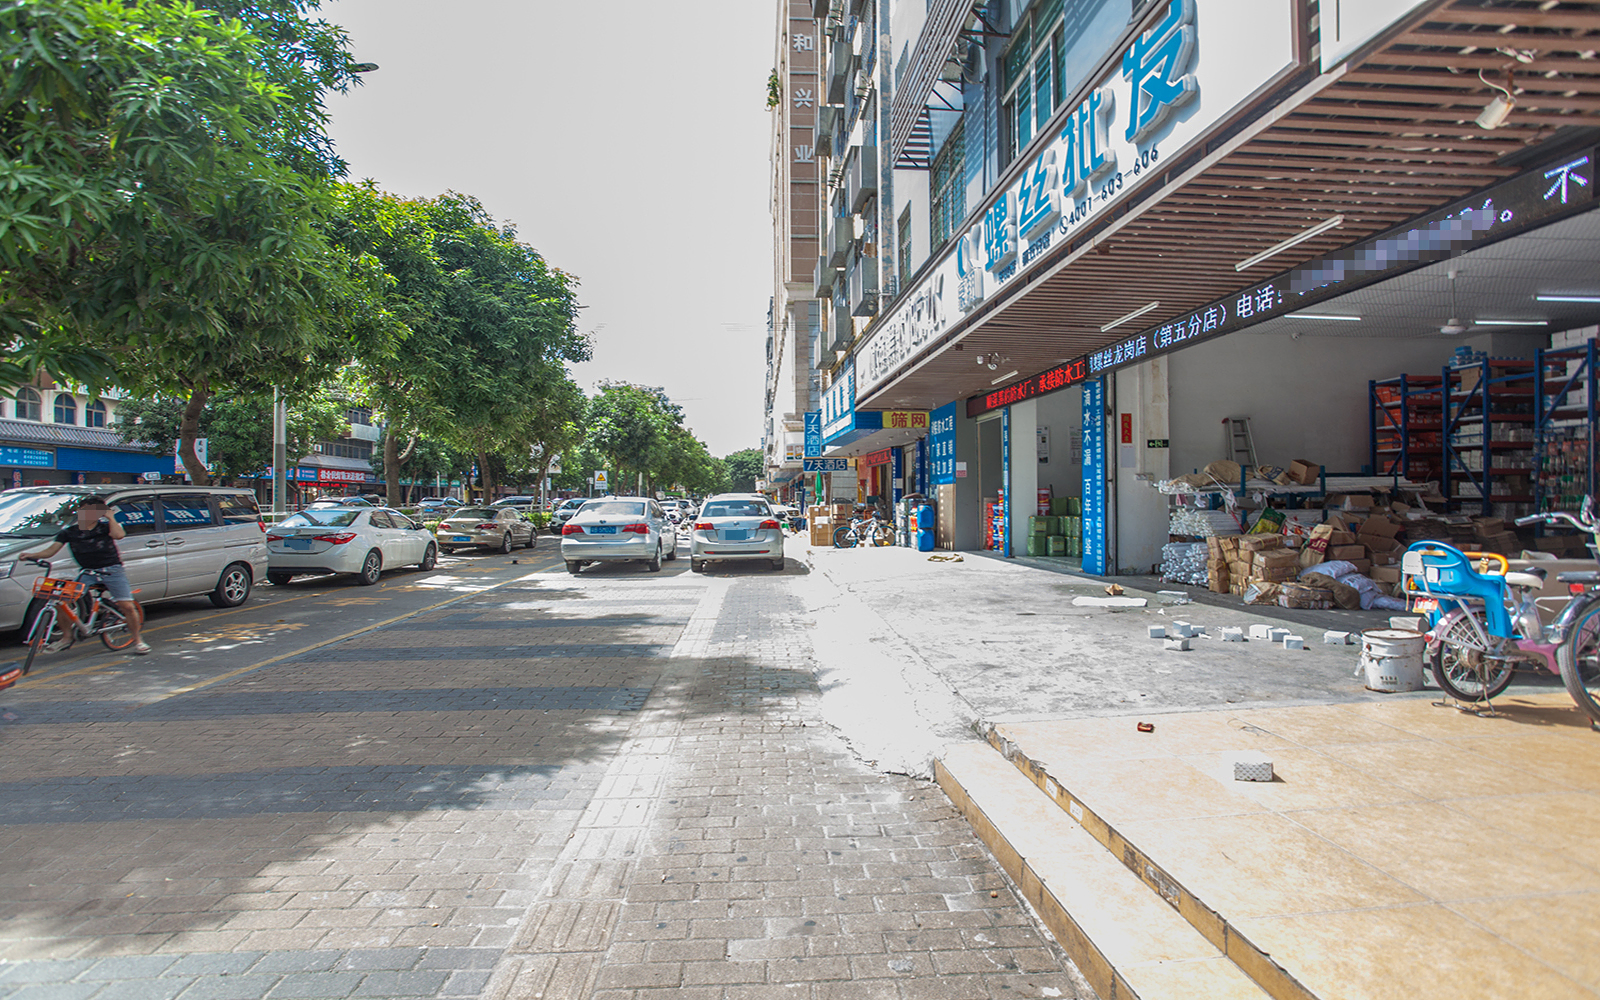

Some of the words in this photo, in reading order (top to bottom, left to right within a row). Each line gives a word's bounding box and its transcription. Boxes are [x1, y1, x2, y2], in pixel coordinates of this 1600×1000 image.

[793, 33, 814, 163] 和兴业
[984, 0, 1189, 271] 螺丝批发
[1543, 155, 1589, 204] 不
[807, 414, 820, 456] 7天酒店
[891, 412, 926, 428] 筛网
[805, 459, 846, 470] 7天酒店
